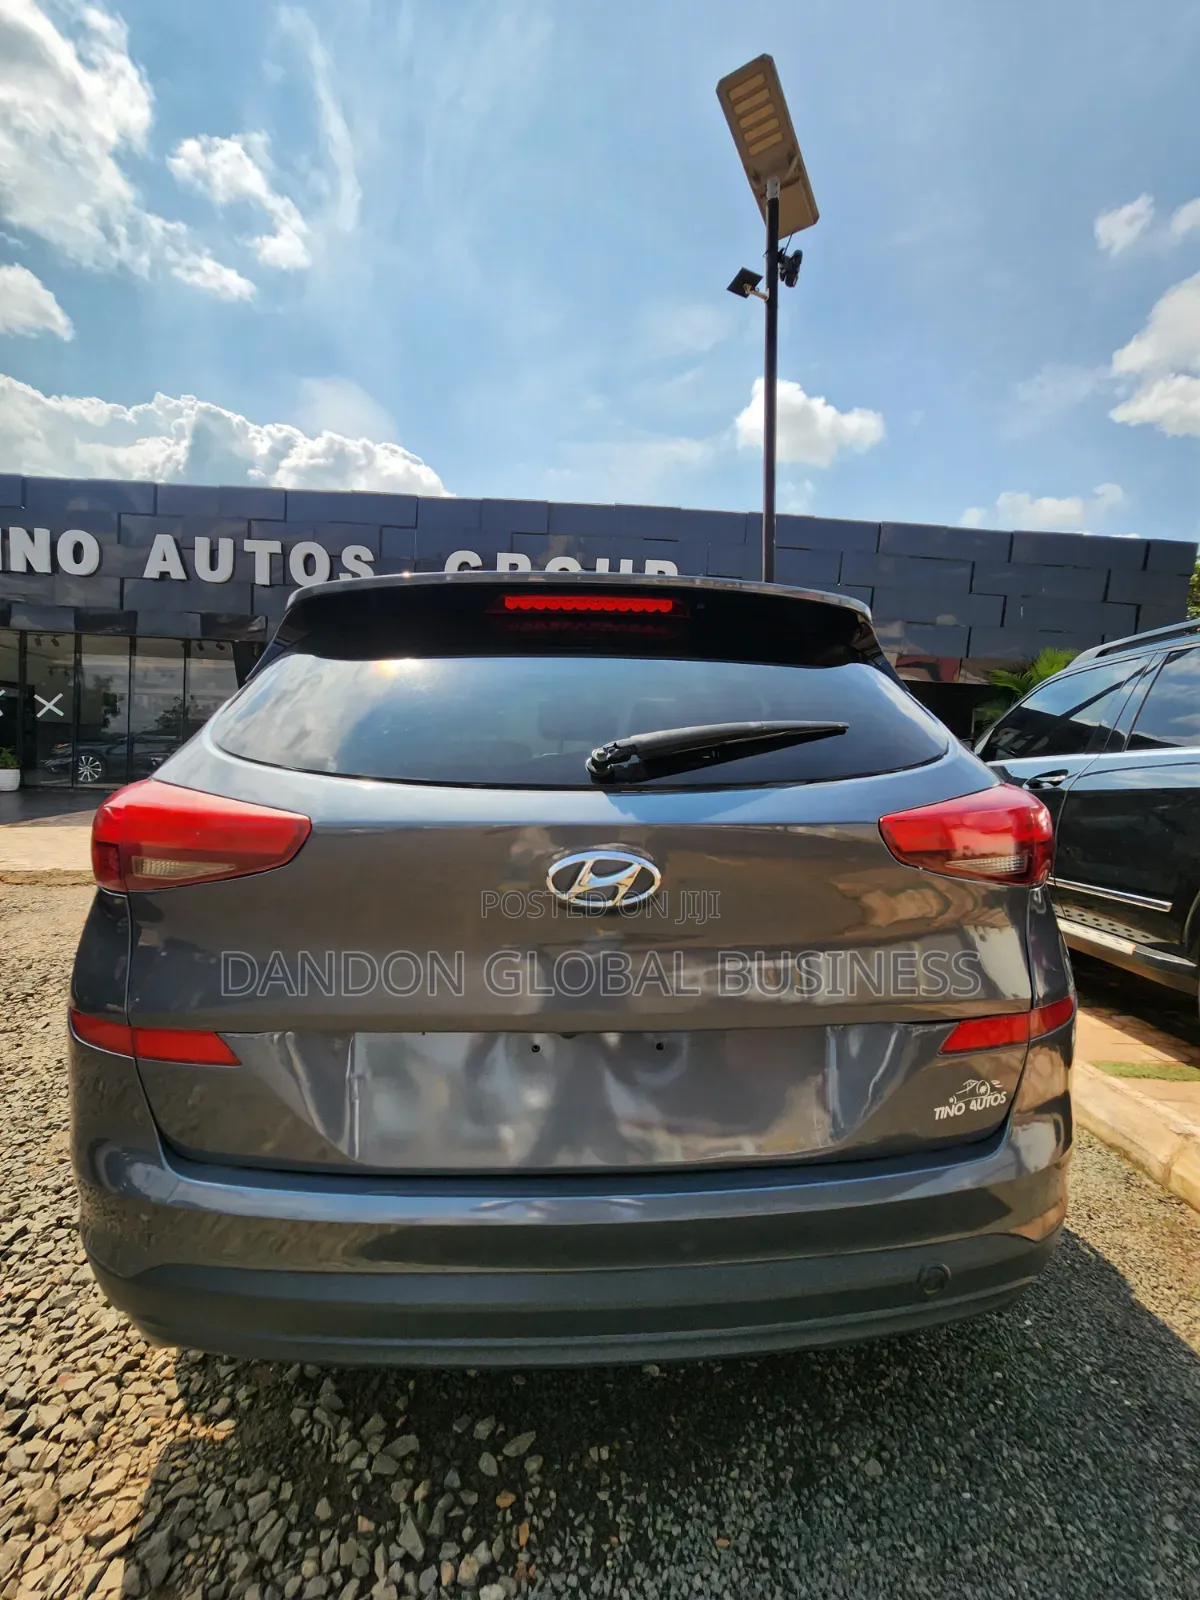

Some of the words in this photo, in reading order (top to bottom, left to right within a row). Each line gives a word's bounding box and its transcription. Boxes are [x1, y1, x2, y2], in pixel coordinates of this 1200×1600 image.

[0, 526, 101, 576] NO
[142, 533, 375, 587] AUTOS
[933, 1102, 965, 1120] TINO
[969, 1091, 1007, 1111] AUTOS
